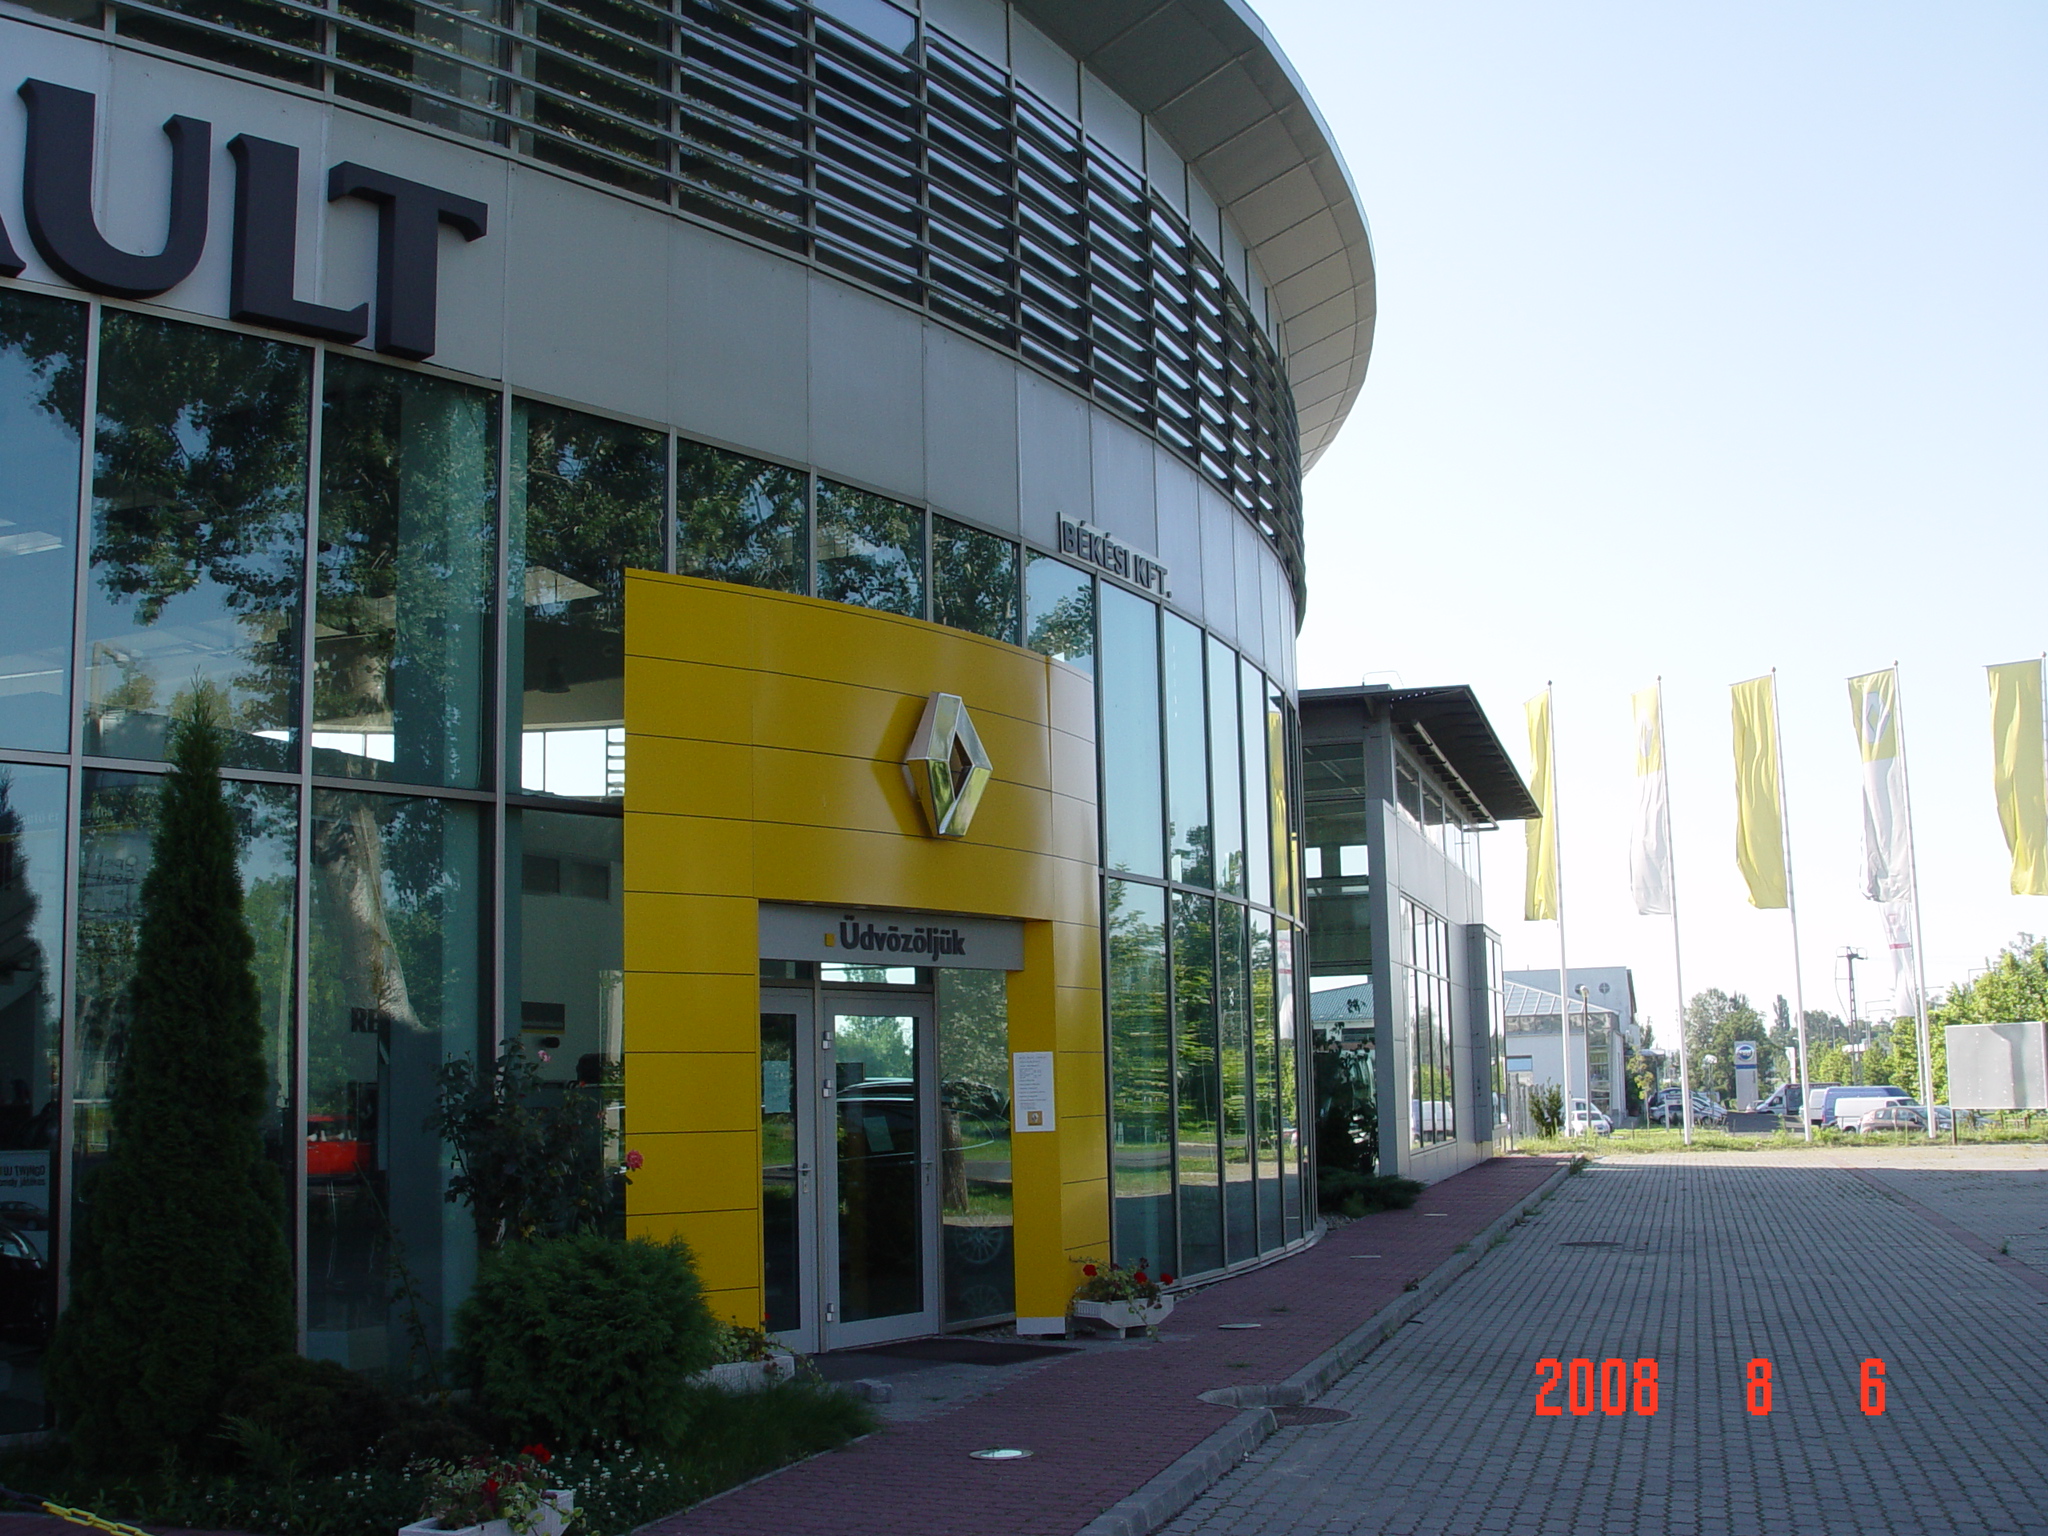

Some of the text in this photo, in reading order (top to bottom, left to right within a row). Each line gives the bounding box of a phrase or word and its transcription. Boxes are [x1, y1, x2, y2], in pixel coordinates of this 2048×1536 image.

[0, 77, 488, 361] ULT
[1062, 520, 1172, 598] BÉKÉSI KFT.
[840, 914, 966, 961] Üdvözöljük
